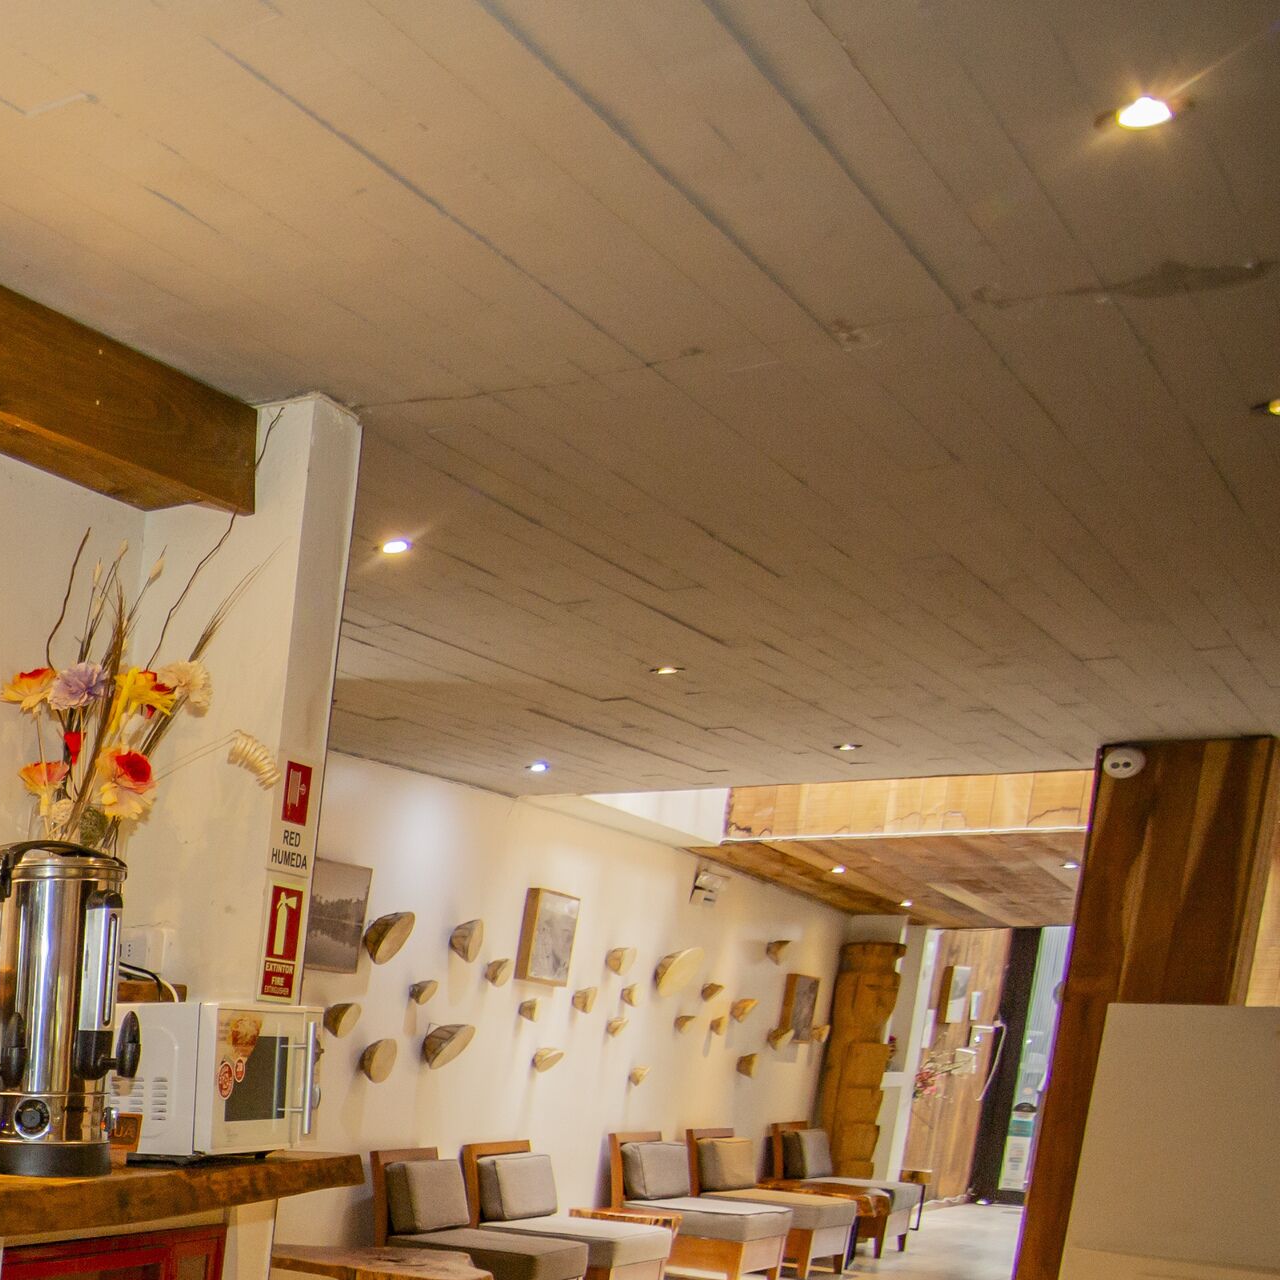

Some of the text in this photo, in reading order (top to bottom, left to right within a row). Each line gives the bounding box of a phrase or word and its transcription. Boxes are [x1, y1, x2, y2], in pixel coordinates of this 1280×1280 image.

[282, 829, 301, 847] RED
[271, 847, 307, 870] HUMEDA
[265, 962, 295, 974] EXTINTOR
[271, 976, 285, 987] FIRE
